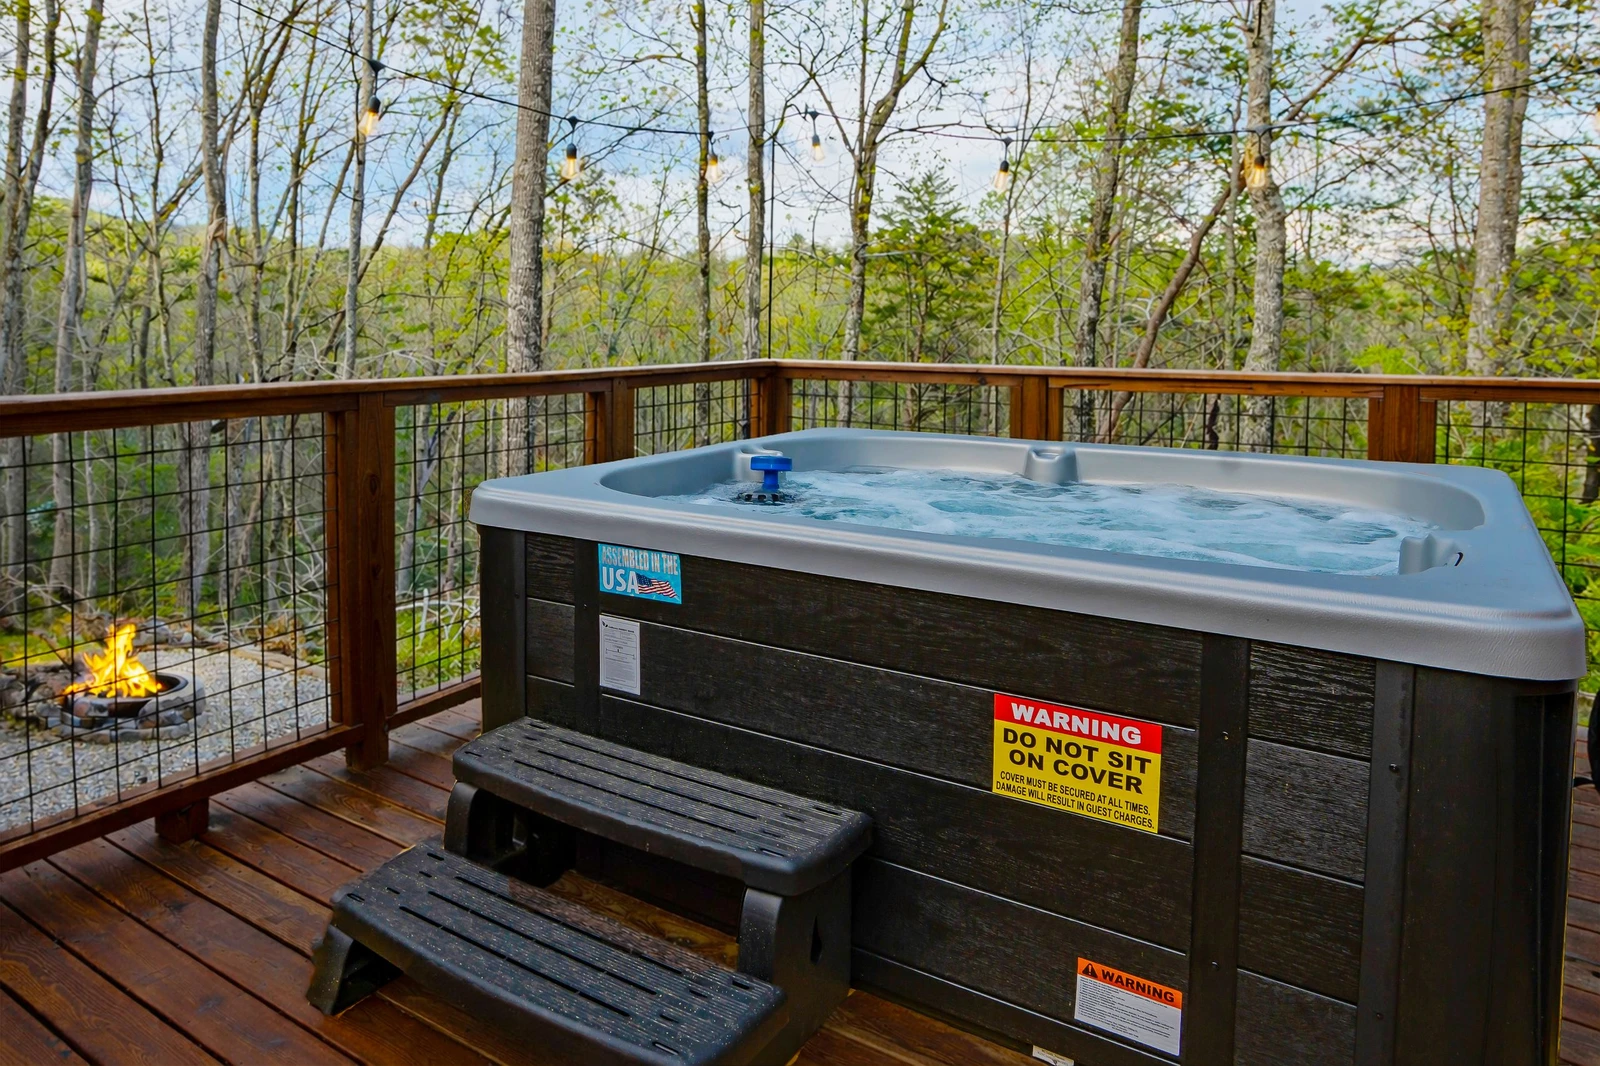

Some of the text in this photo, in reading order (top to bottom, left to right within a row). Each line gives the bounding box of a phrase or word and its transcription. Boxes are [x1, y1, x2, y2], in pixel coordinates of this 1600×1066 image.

[602, 546, 678, 575] ASSEMBLED IN THE
[602, 567, 639, 594] USA
[1011, 702, 1141, 744] WARNING
[1003, 728, 1151, 774] DO NOT SIT
[1009, 750, 1143, 794] ON COVER
[996, 780, 1154, 829] DAMAGE WILL RESULT IN GUEST CHARGES.
[1000, 771, 1150, 816] COVER MUST BE SECURED AT ALL TIMES.
[1102, 969, 1174, 1002] WARNING
